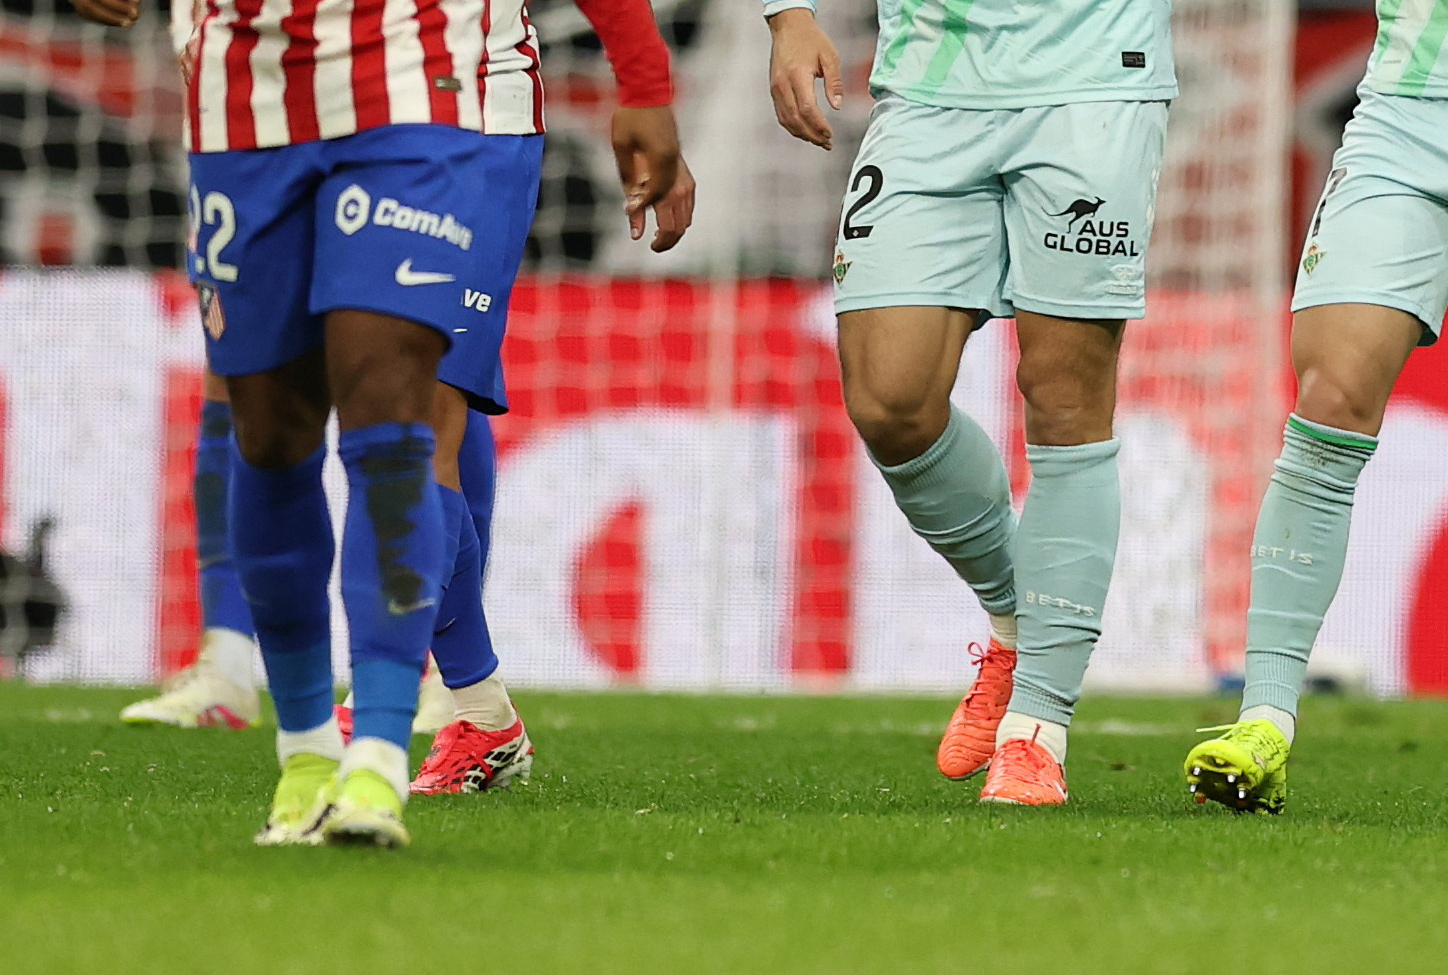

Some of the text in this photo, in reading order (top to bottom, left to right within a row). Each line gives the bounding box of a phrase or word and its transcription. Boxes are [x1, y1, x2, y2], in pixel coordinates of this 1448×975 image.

[843, 165, 884, 241] 2
[1078, 220, 1129, 238] AUS
[1044, 232, 1139, 257] GLOBAL
[1026, 591, 1095, 618] BETIS
